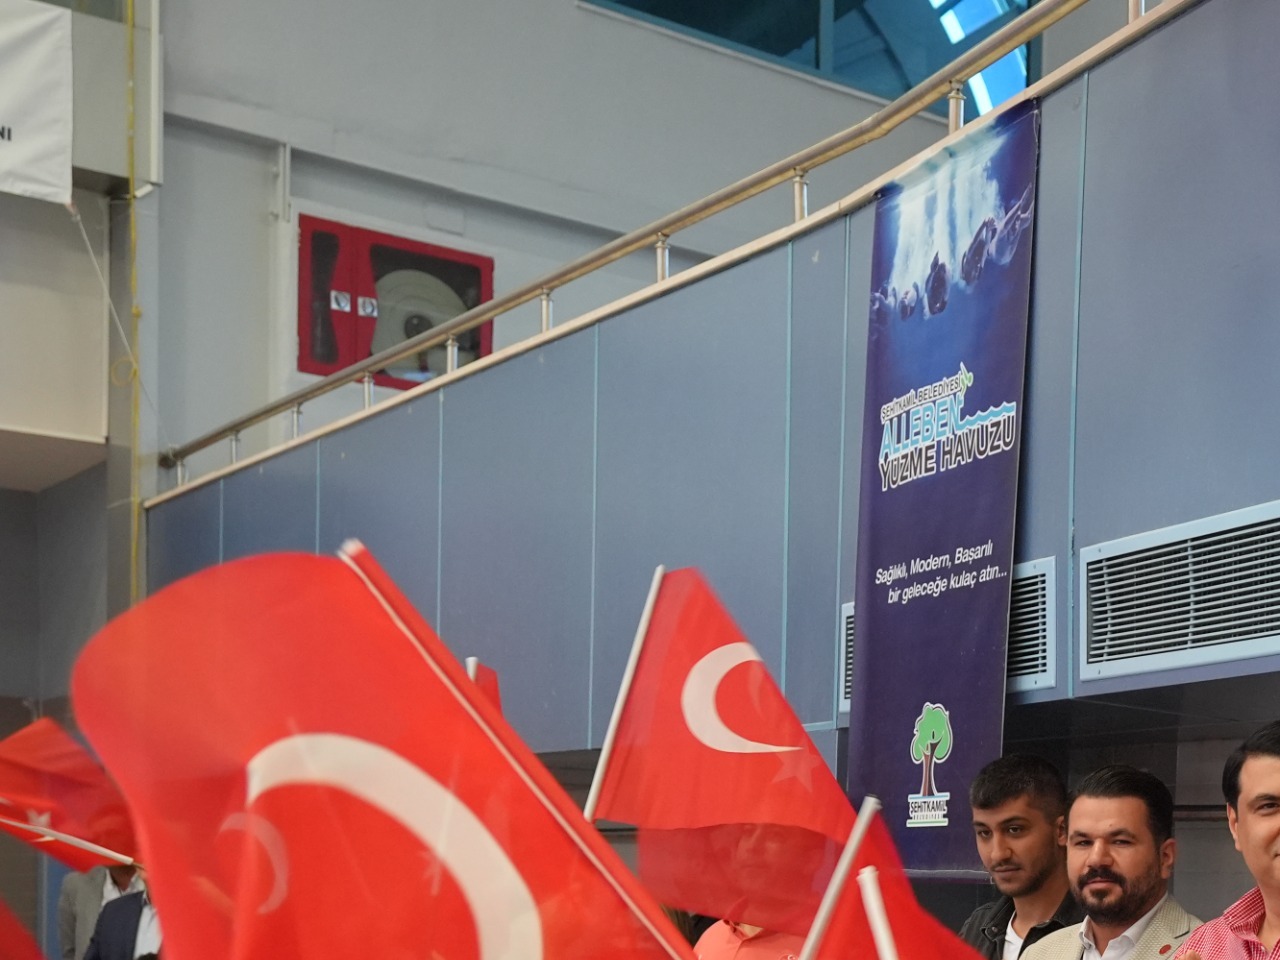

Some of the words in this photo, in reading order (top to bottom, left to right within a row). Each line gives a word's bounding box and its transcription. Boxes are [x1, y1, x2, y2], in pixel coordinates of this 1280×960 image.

[880, 393, 964, 461] ALLEBEN
[940, 415, 1016, 471] HAVUZU
[910, 554, 952, 576] Modern,
[954, 539, 993, 565] Başarılı
[888, 587, 901, 604] bir
[902, 576, 947, 604] geleceğe
[949, 570, 977, 588] kulaç
